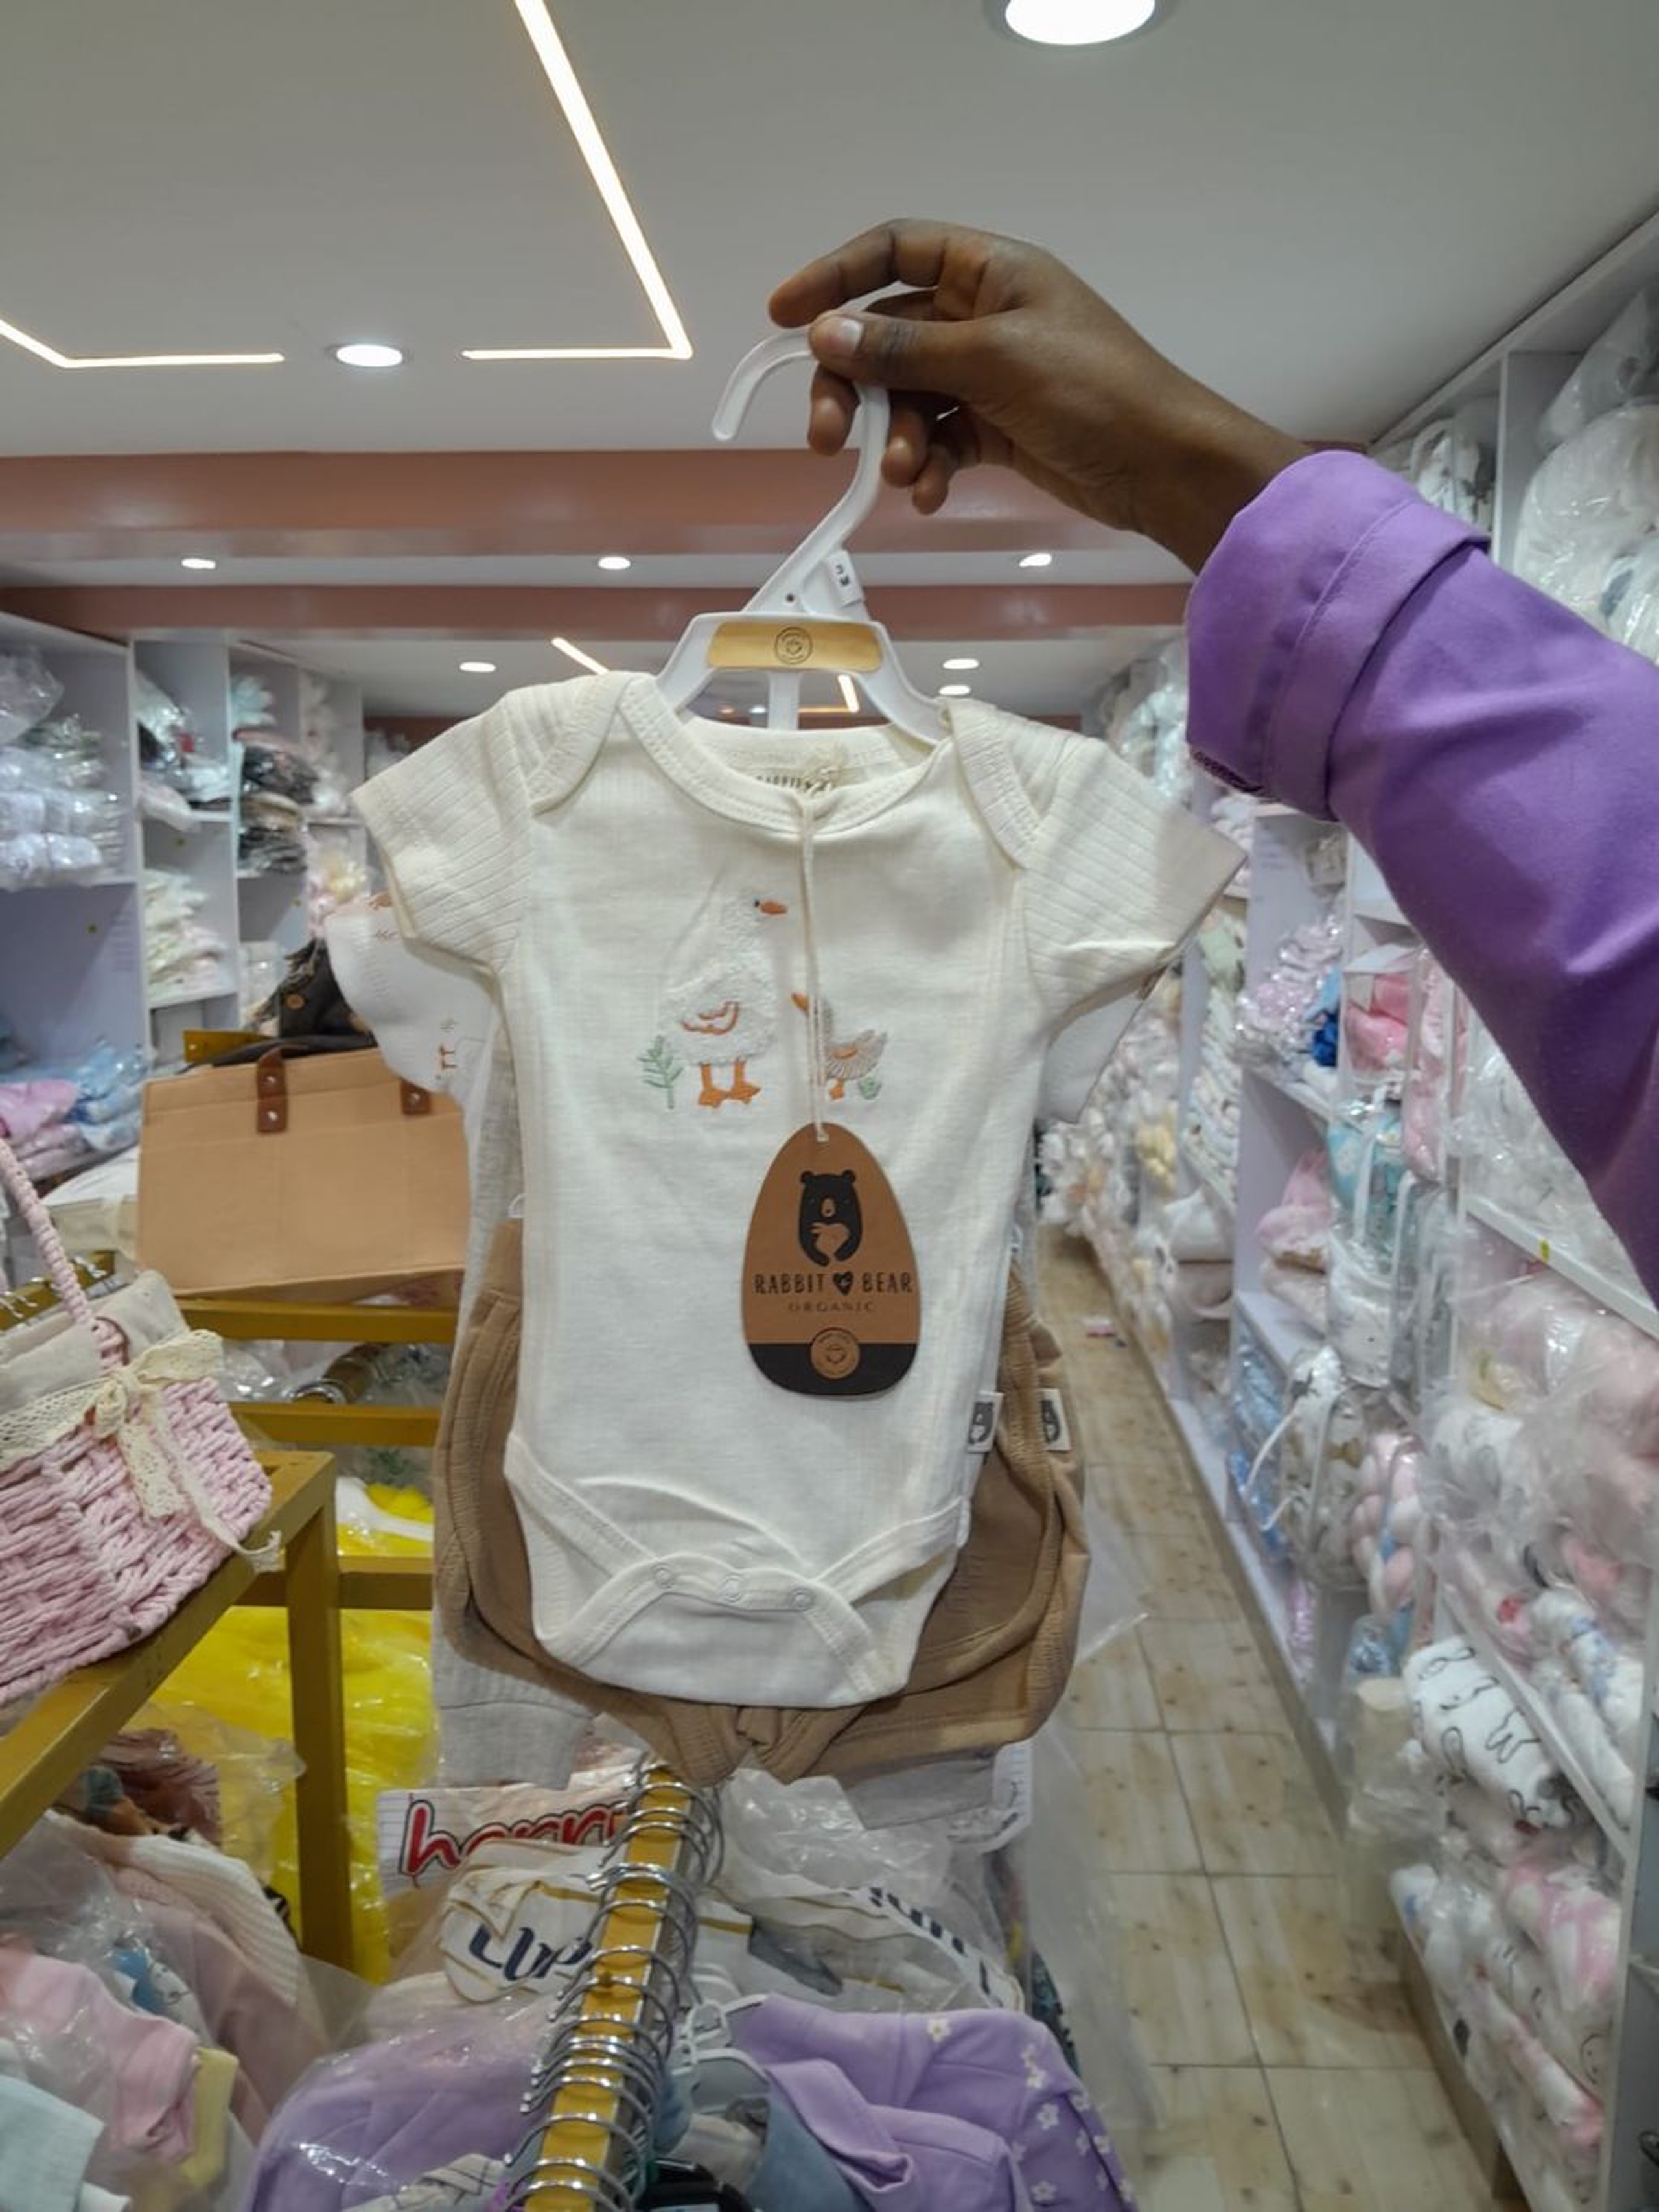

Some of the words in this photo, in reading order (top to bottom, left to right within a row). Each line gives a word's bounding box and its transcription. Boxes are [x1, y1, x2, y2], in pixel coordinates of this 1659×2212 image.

[754, 1273, 825, 1294] RABBIT
[861, 1272, 912, 1293] BEAR
[788, 1301, 874, 1312] ORGANIC
